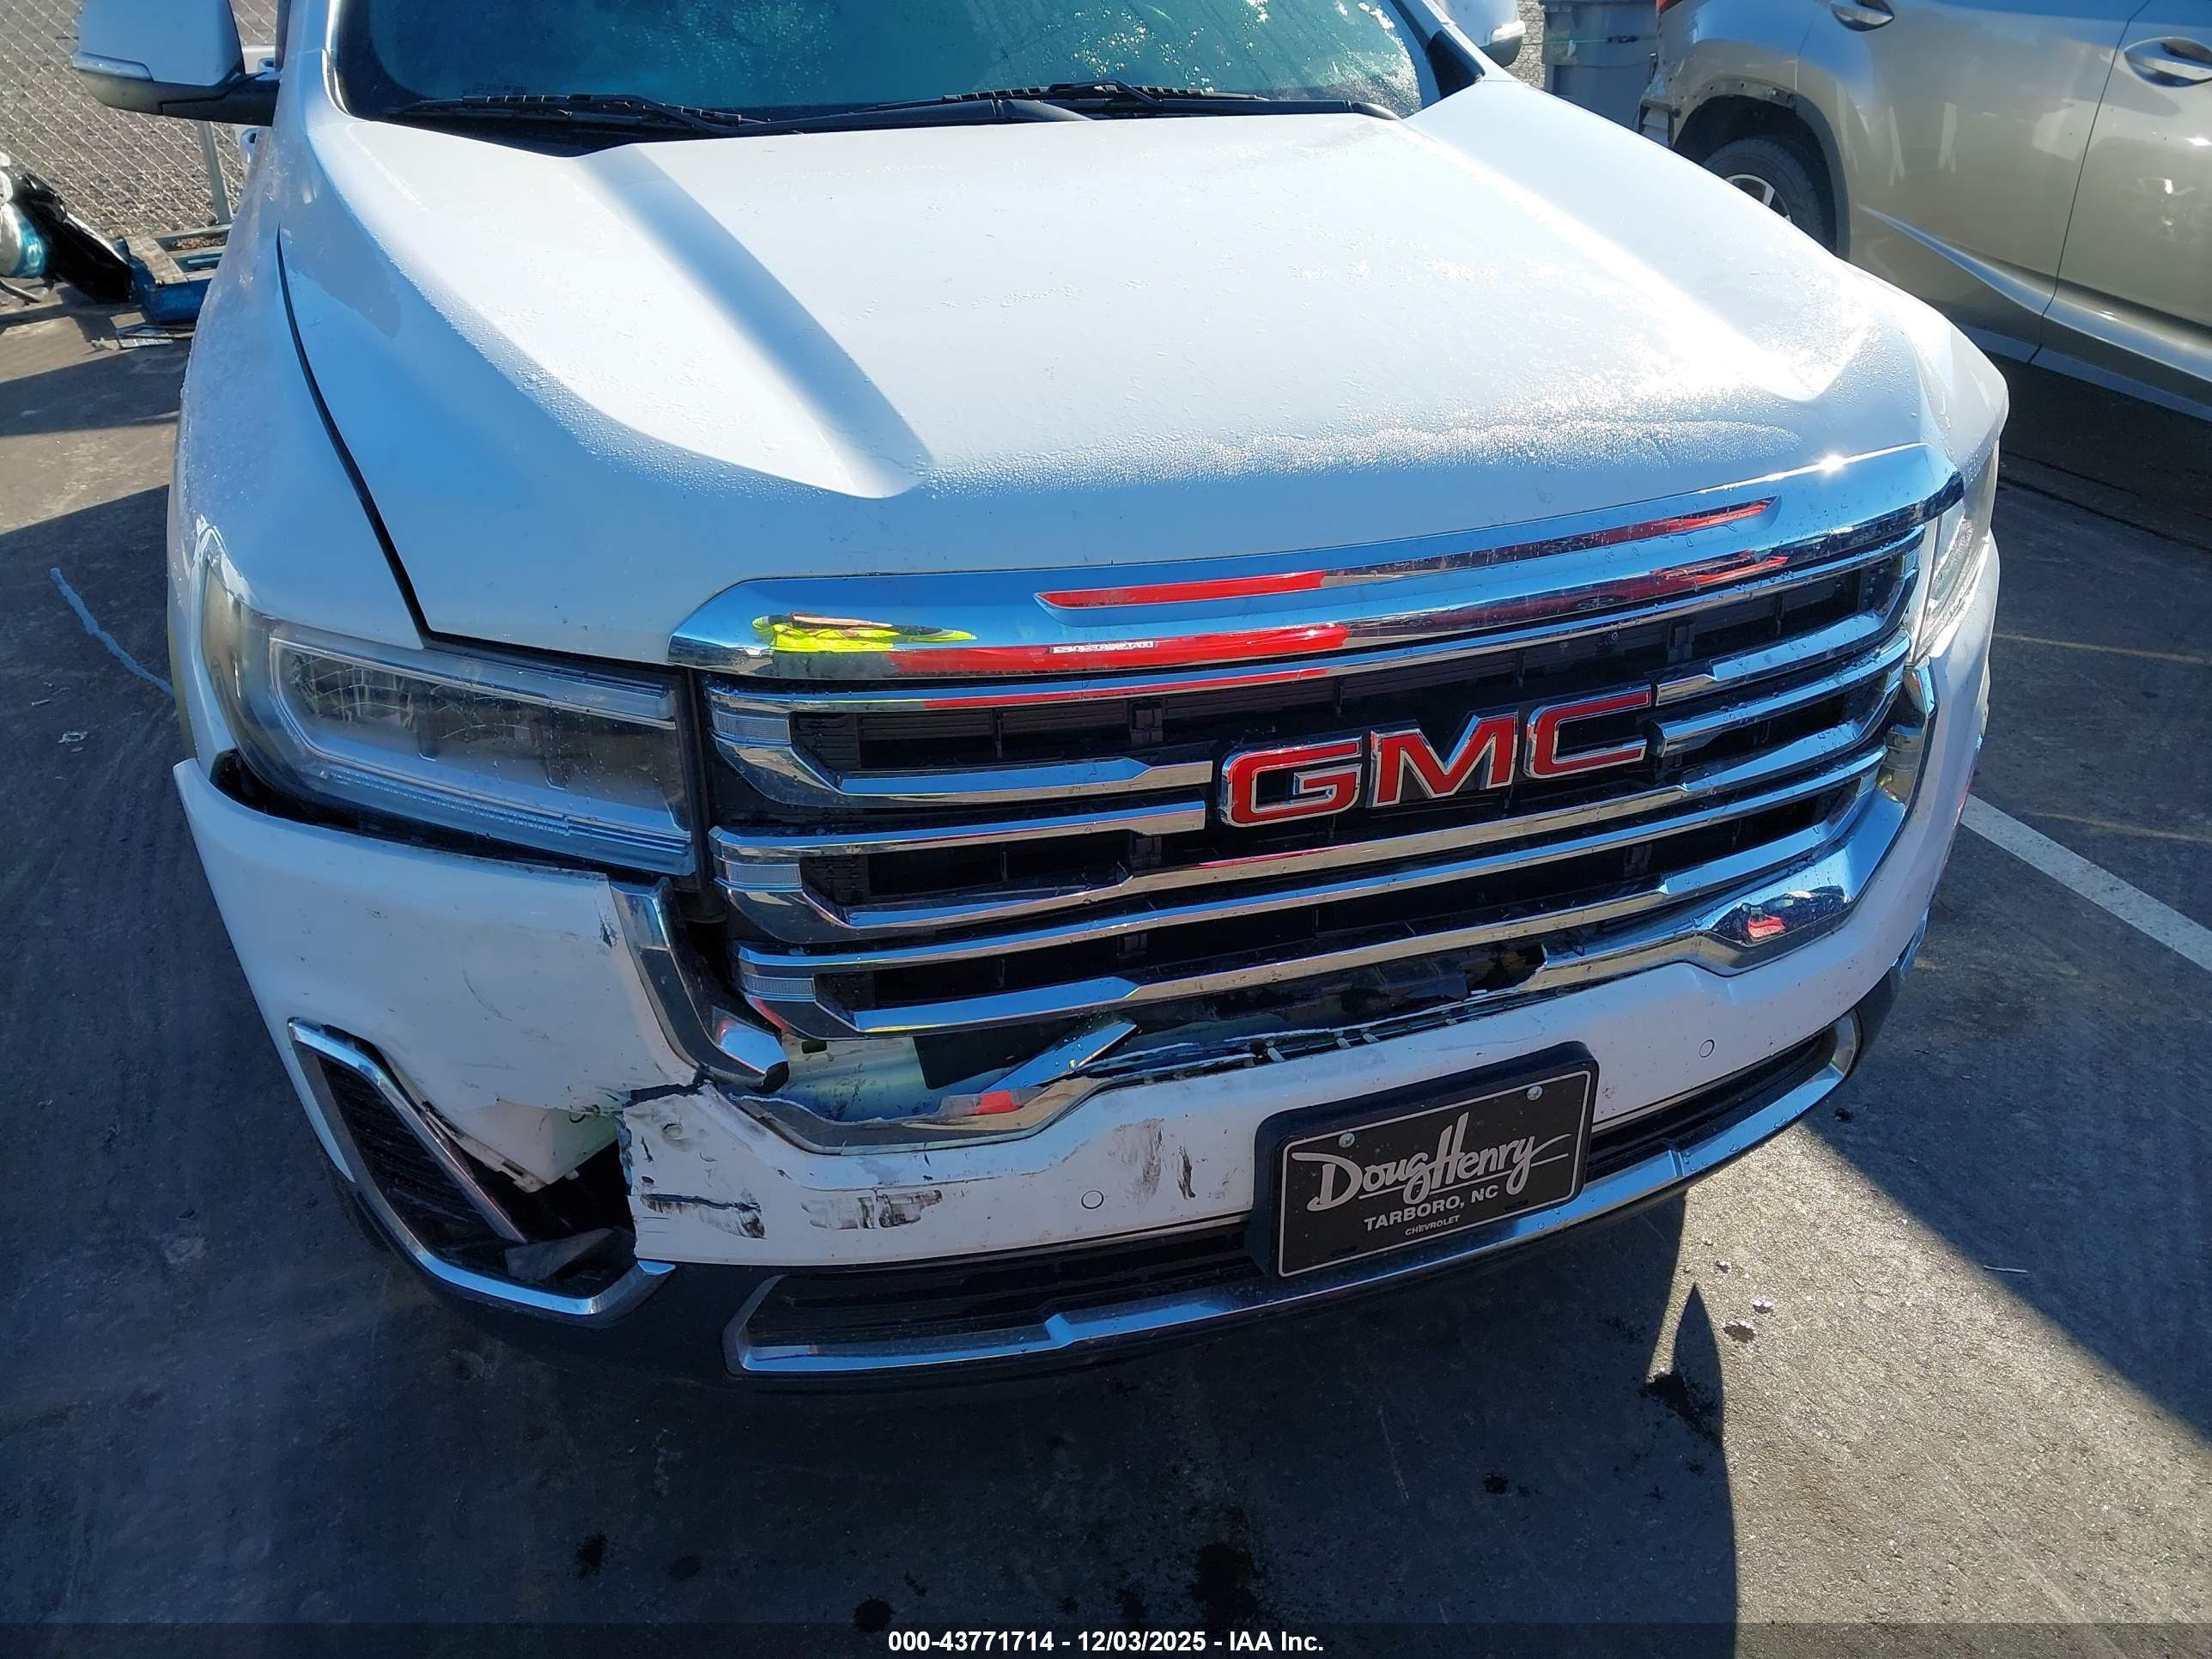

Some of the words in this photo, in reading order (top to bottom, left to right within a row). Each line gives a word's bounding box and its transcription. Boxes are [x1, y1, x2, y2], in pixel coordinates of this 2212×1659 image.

[1219, 684, 1652, 829] GMC
[1364, 1195, 1465, 1231] TARBORO,
[1470, 1184, 1499, 1204] NC
[1405, 1215, 1461, 1237] CHEVROLET
